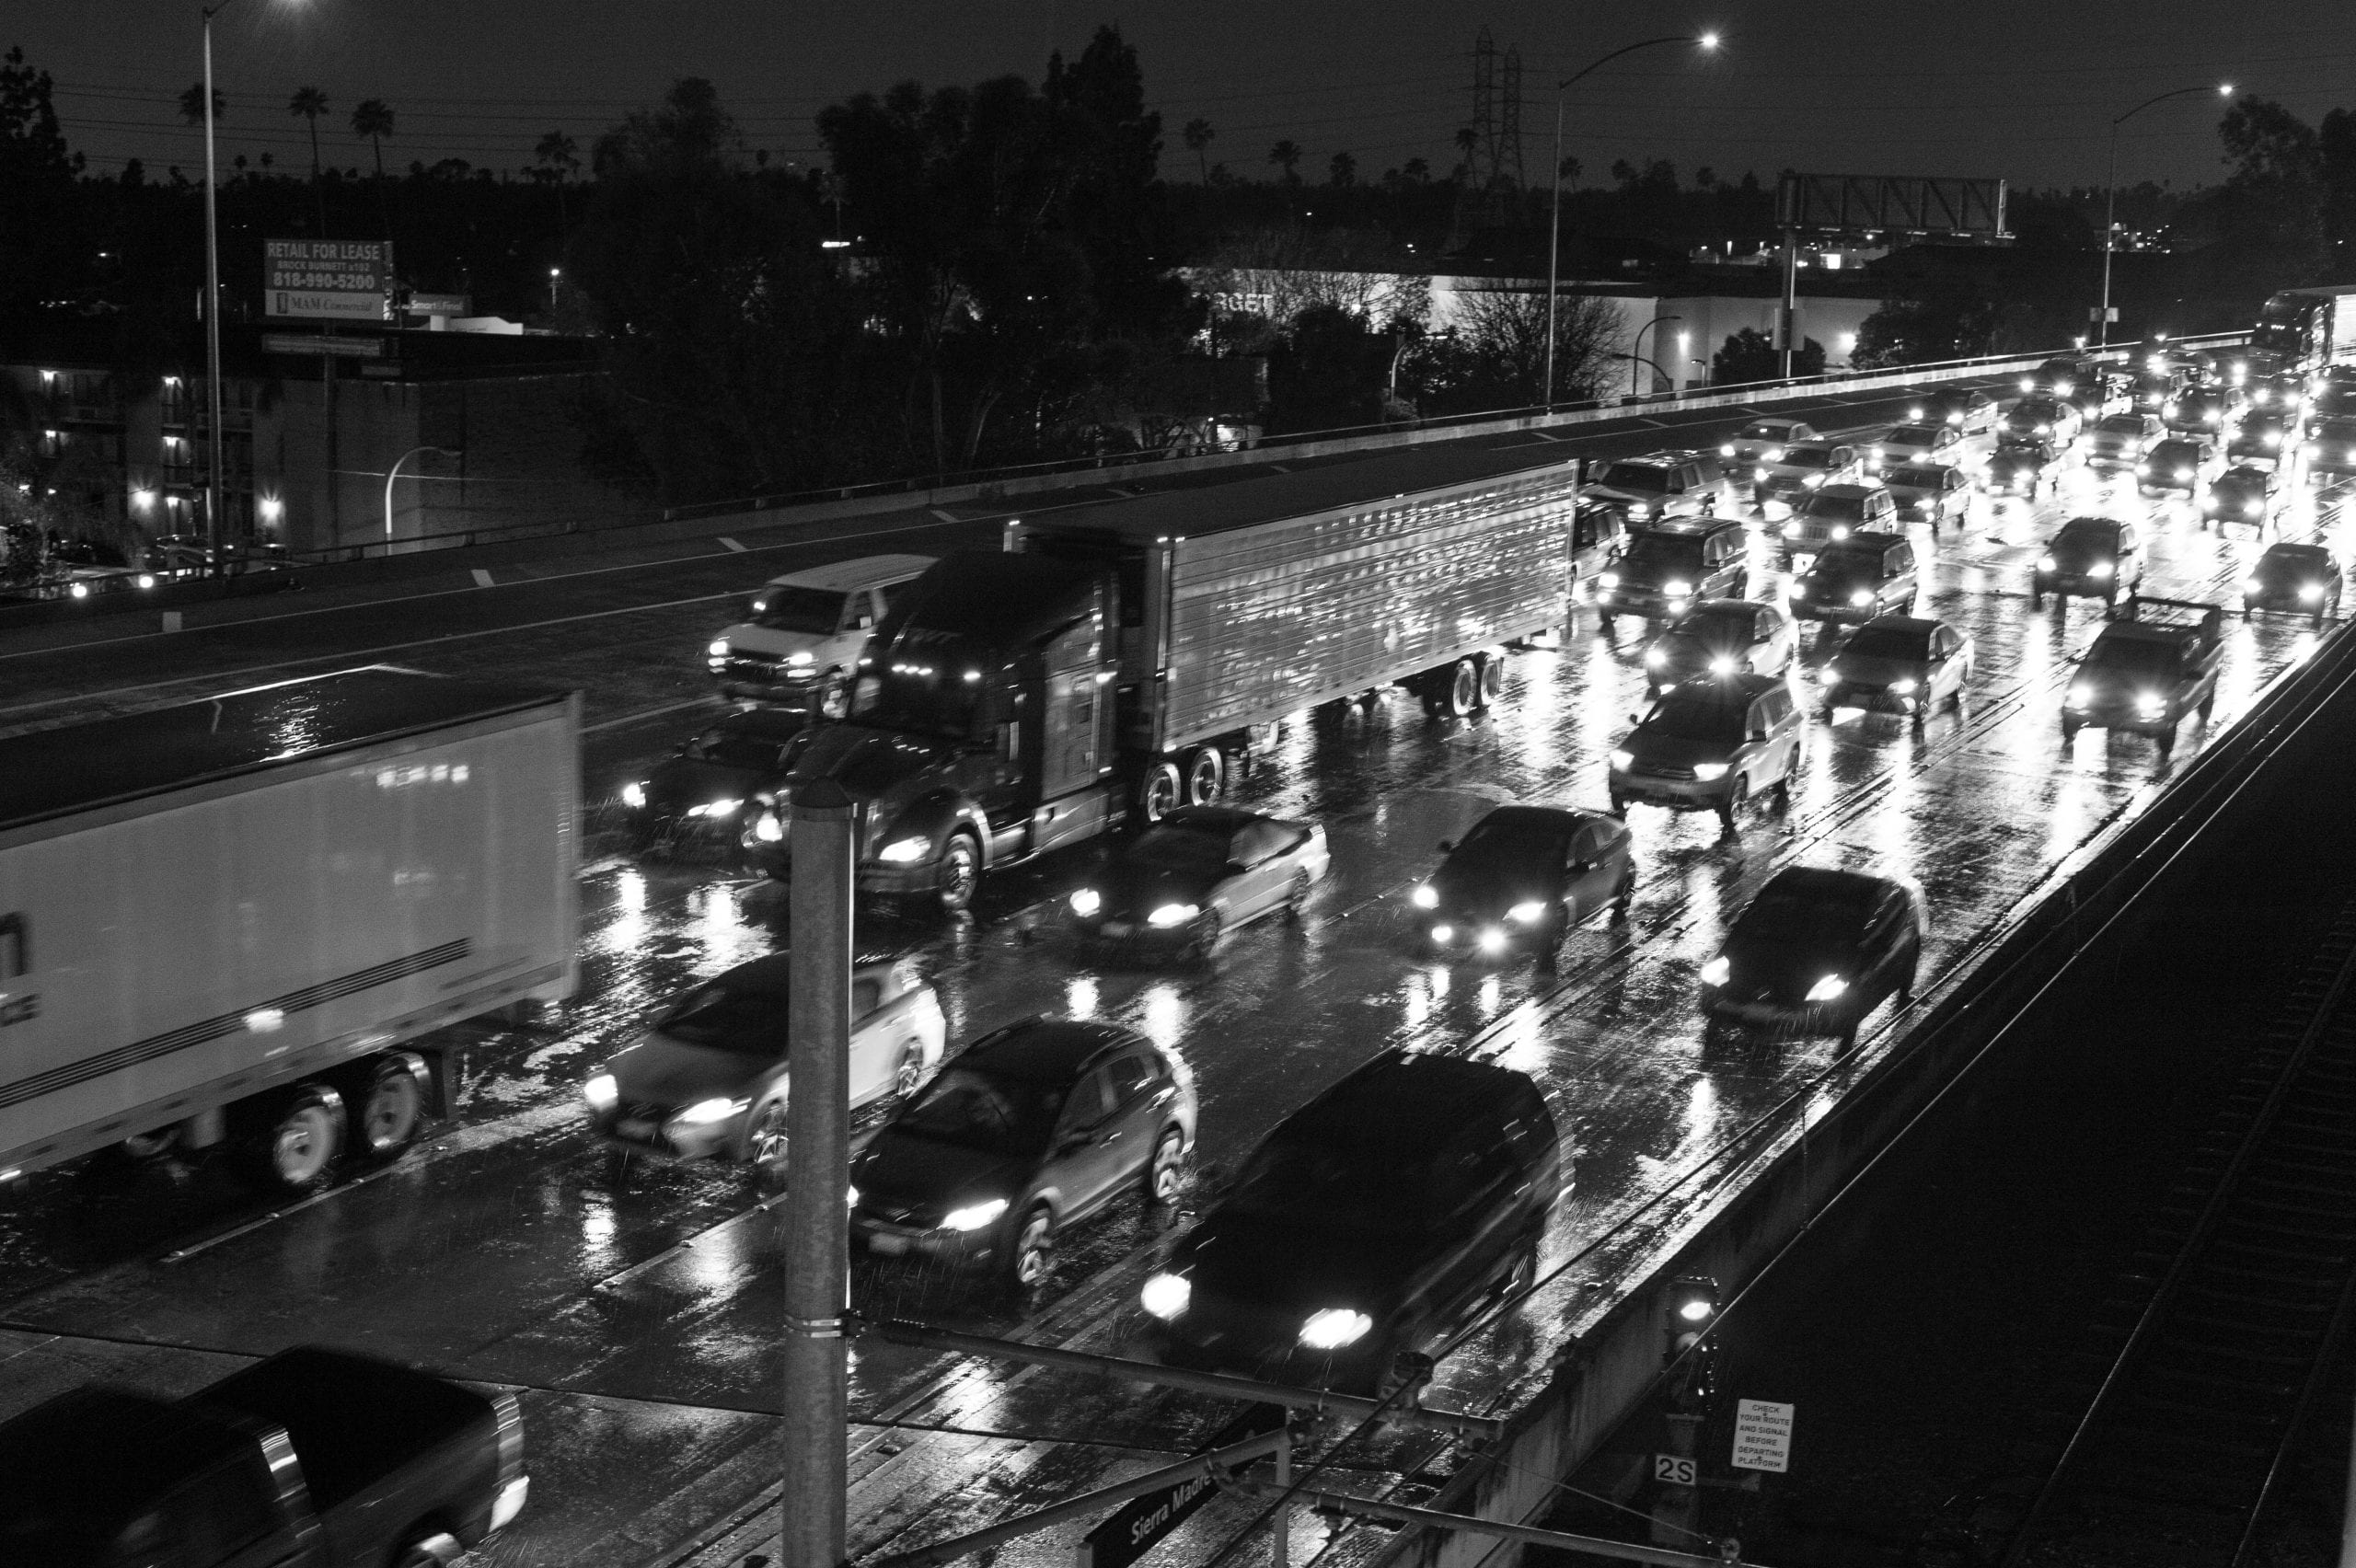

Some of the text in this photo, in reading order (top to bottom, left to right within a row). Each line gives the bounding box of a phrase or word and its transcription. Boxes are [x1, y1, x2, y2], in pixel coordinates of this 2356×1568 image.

[268, 243, 380, 260] RETAIL FOR LEASE
[273, 272, 375, 291] 818-990-5200
[1191, 292, 1274, 313] RGET
[1752, 1404, 1780, 1414] CHECK
[1739, 1413, 1790, 1426] YOUR ROUTE
[1759, 1426, 1788, 1436] SIGNAL
[1745, 1435, 1778, 1447] BEFORE
[1738, 1446, 1784, 1458] DEPARTING
[1658, 1458, 1694, 1482] 2S
[1738, 1458, 1781, 1469] PLATFORM
[1131, 1474, 1212, 1545] Sierra Madre
